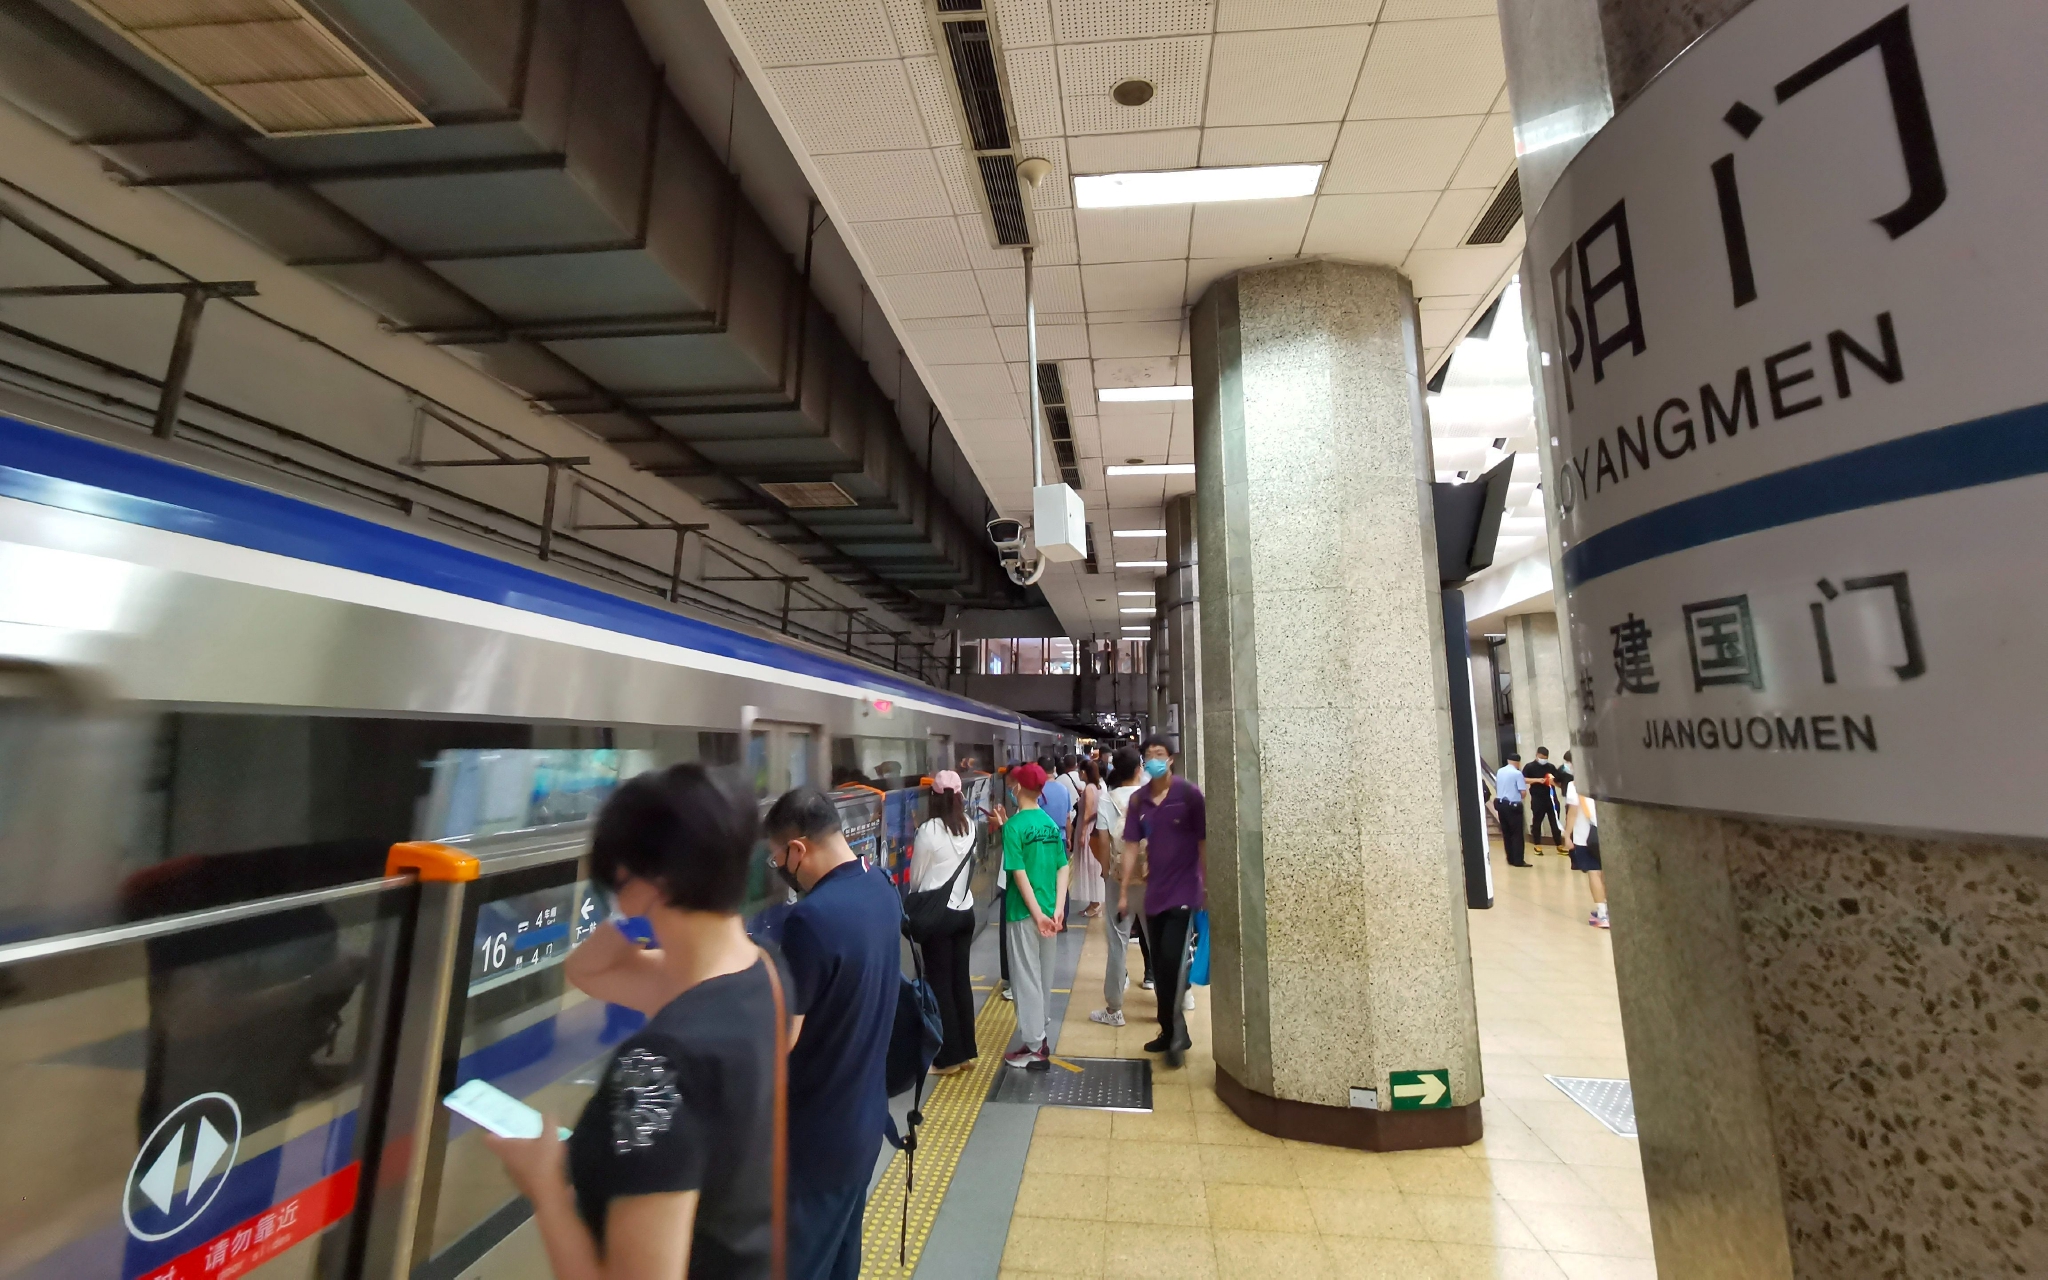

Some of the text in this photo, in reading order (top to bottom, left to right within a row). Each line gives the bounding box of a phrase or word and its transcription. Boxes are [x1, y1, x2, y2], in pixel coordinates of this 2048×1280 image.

[1609, 570, 1927, 695] 建国门
[1642, 714, 1878, 752] JIANGUOMEN
[535, 910, 543, 928] 4
[481, 931, 508, 973] 16
[531, 948, 539, 965] 4
[205, 1199, 299, 1271] 请勿靠近
